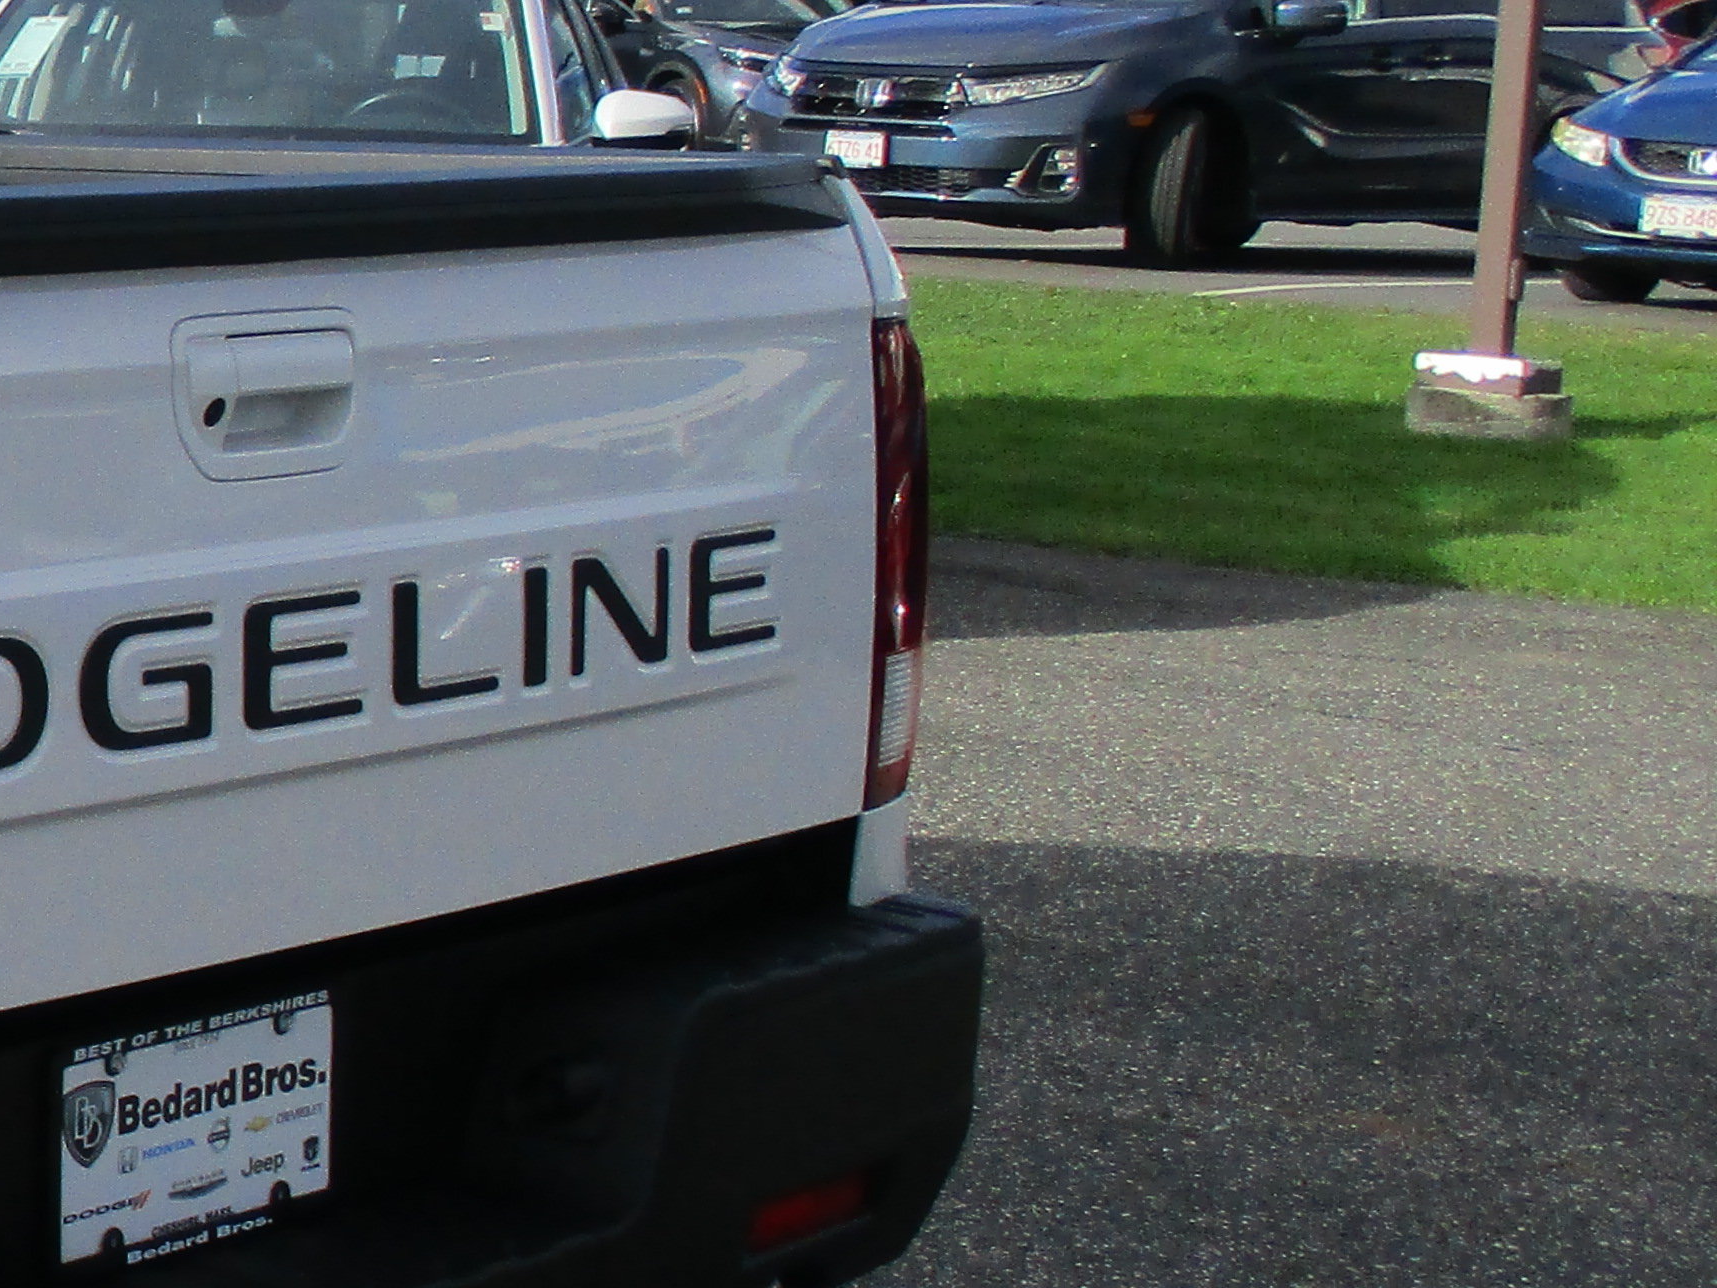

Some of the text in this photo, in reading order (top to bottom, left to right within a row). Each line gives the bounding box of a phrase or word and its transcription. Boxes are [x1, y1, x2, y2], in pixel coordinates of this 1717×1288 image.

[74, 1038, 126, 1062] BEST
[131, 1030, 158, 1047] OF
[165, 1020, 204, 1040] THE
[208, 989, 330, 1030] BERKSHIRES
[117, 1057, 327, 1136] Bedard Bros.
[240, 1152, 286, 1178] Jeep
[127, 1215, 274, 1264] Bedard Bros.
